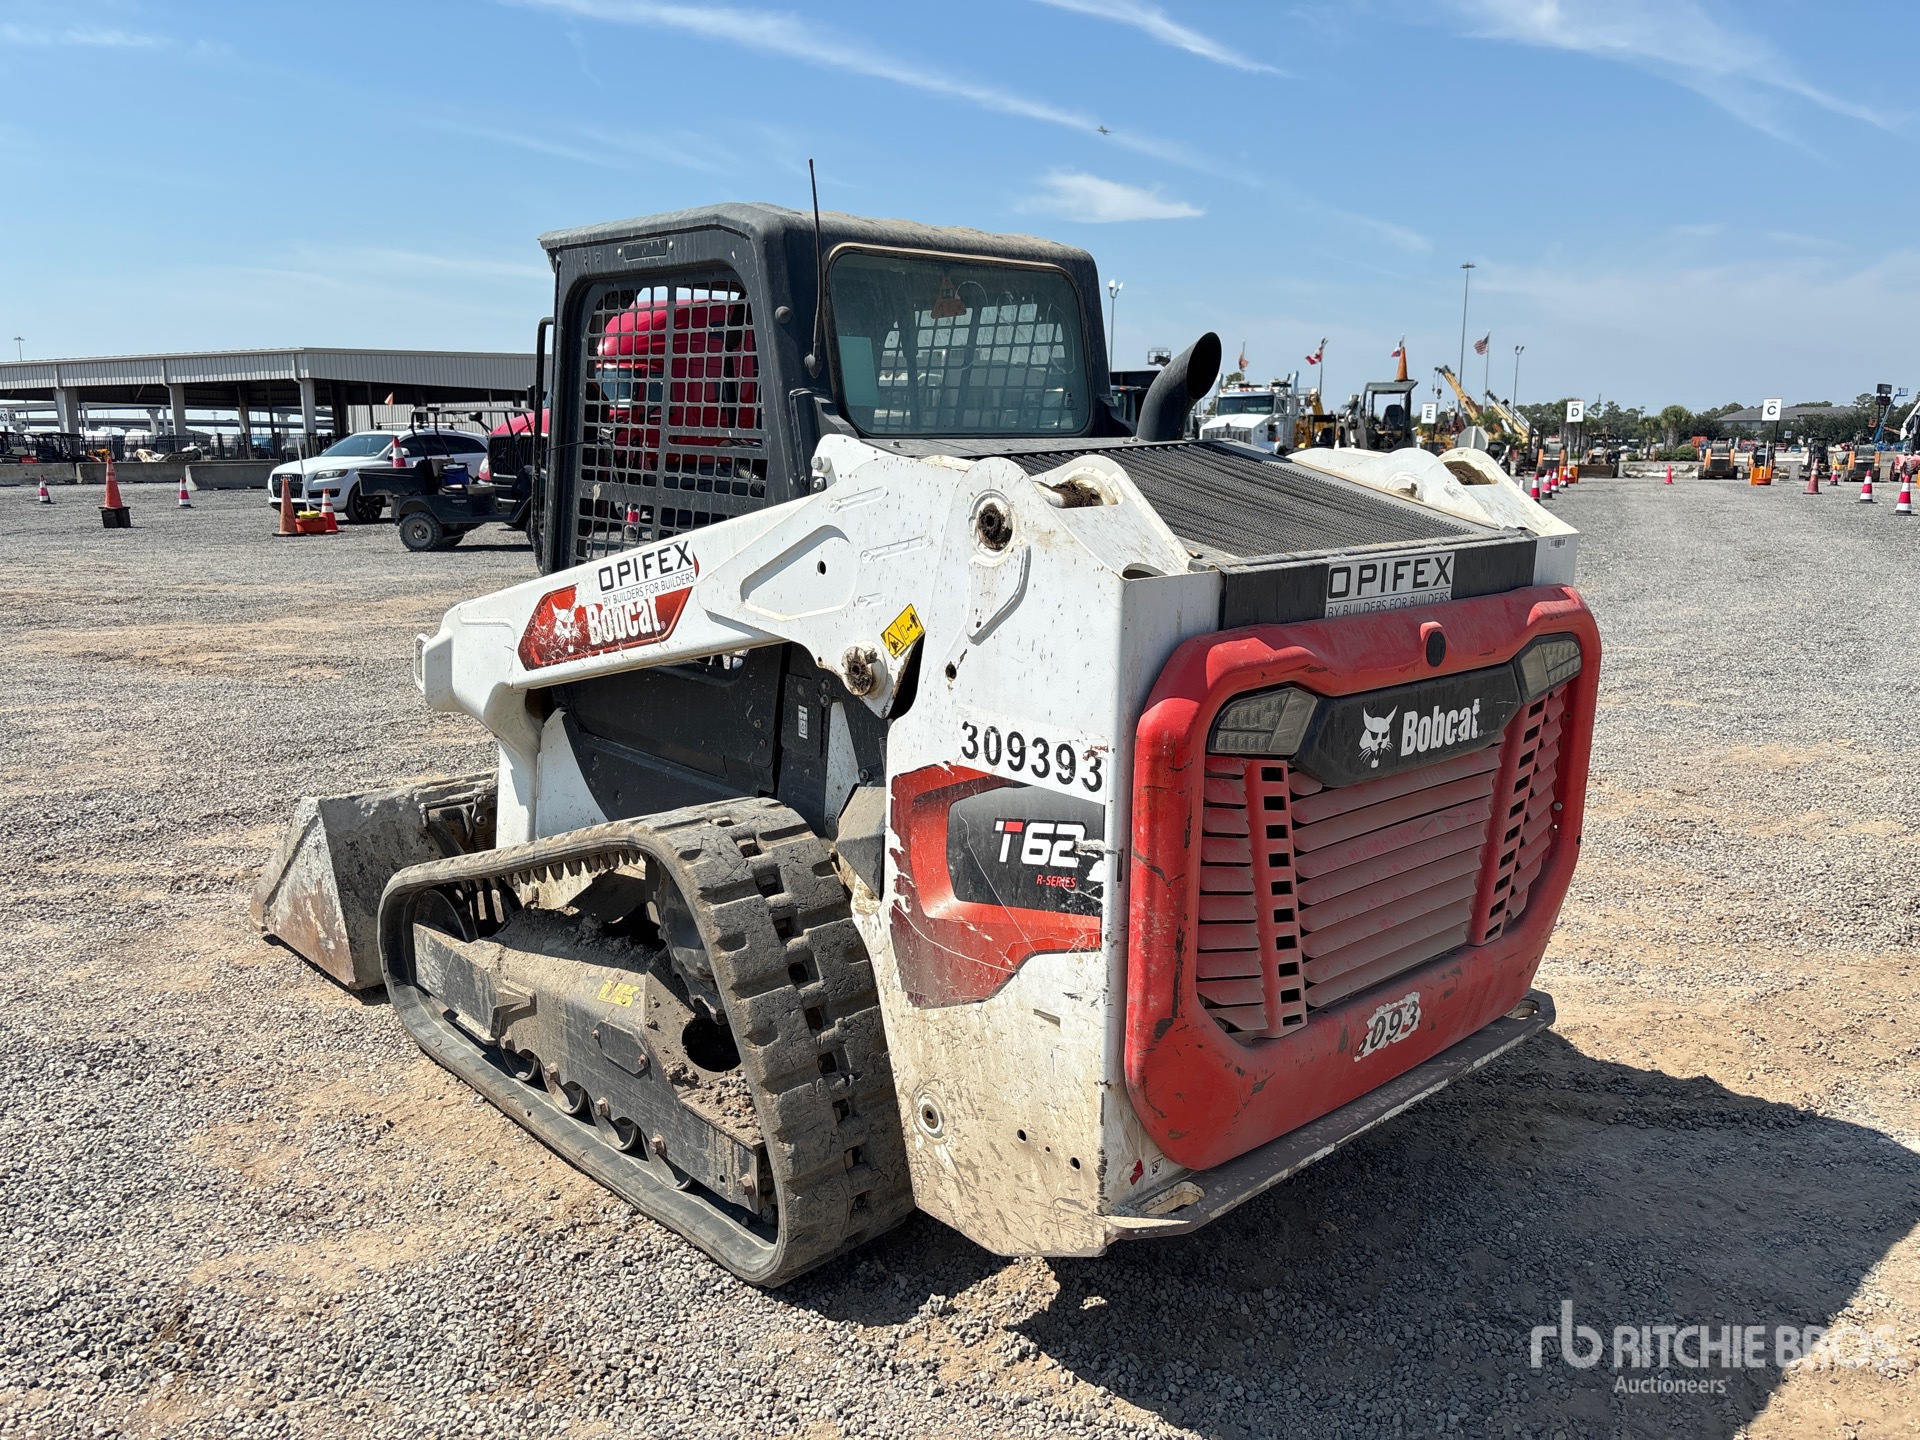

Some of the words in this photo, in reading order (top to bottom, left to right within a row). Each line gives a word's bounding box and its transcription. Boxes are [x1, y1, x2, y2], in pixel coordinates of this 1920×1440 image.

[1426, 410, 1432, 418] E
[1571, 407, 1579, 417] D
[1767, 405, 1777, 415] C
[598, 541, 693, 591] OPIFEX
[1328, 555, 1452, 599] OPIFEX
[603, 597, 612, 607] BY
[613, 586, 644, 604] BUILDERS
[645, 583, 660, 595] FOR
[661, 571, 695, 591] BUILDERS
[1328, 606, 1341, 617] BY
[1343, 600, 1387, 616] BUILDERS
[1389, 597, 1407, 610] FOR
[1409, 591, 1449, 607] BUILDERS
[1400, 698, 1480, 757] Bobcat
[961, 721, 1103, 792] 309393
[994, 819, 1087, 869] T62
[1036, 874, 1076, 888] R-SERIES
